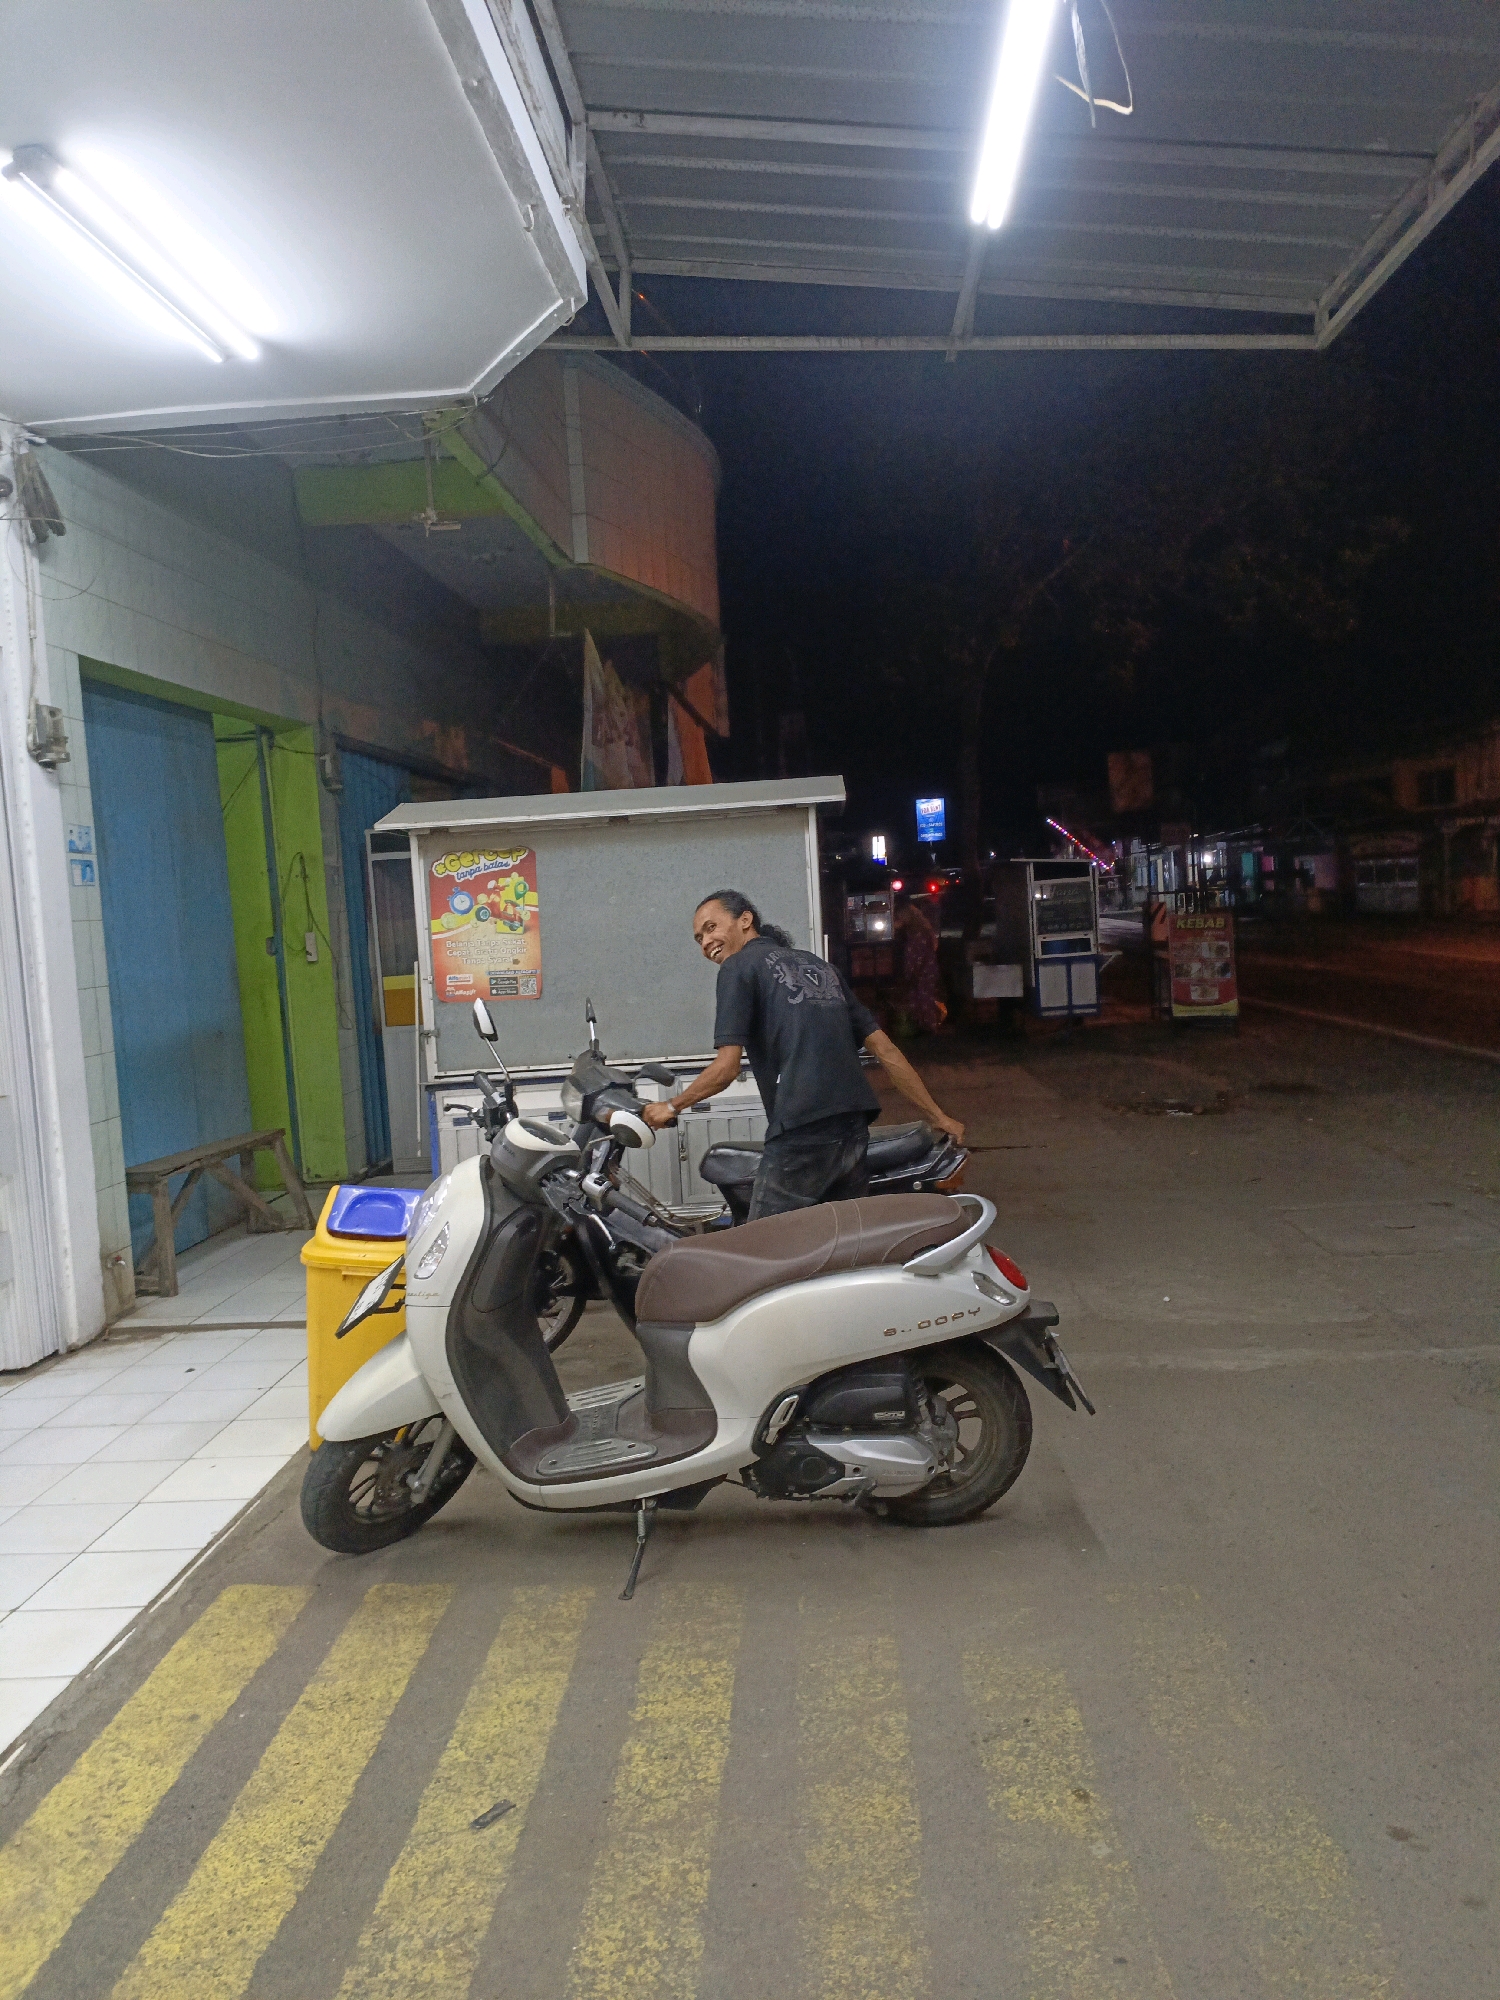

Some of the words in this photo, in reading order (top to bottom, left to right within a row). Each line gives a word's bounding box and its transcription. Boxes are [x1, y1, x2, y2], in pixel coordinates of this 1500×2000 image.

[456, 865, 482, 881] tanpa
[483, 860, 510, 872] batas
[1176, 917, 1226, 929] KEBAB
[500, 947, 527, 956] Ongkir
